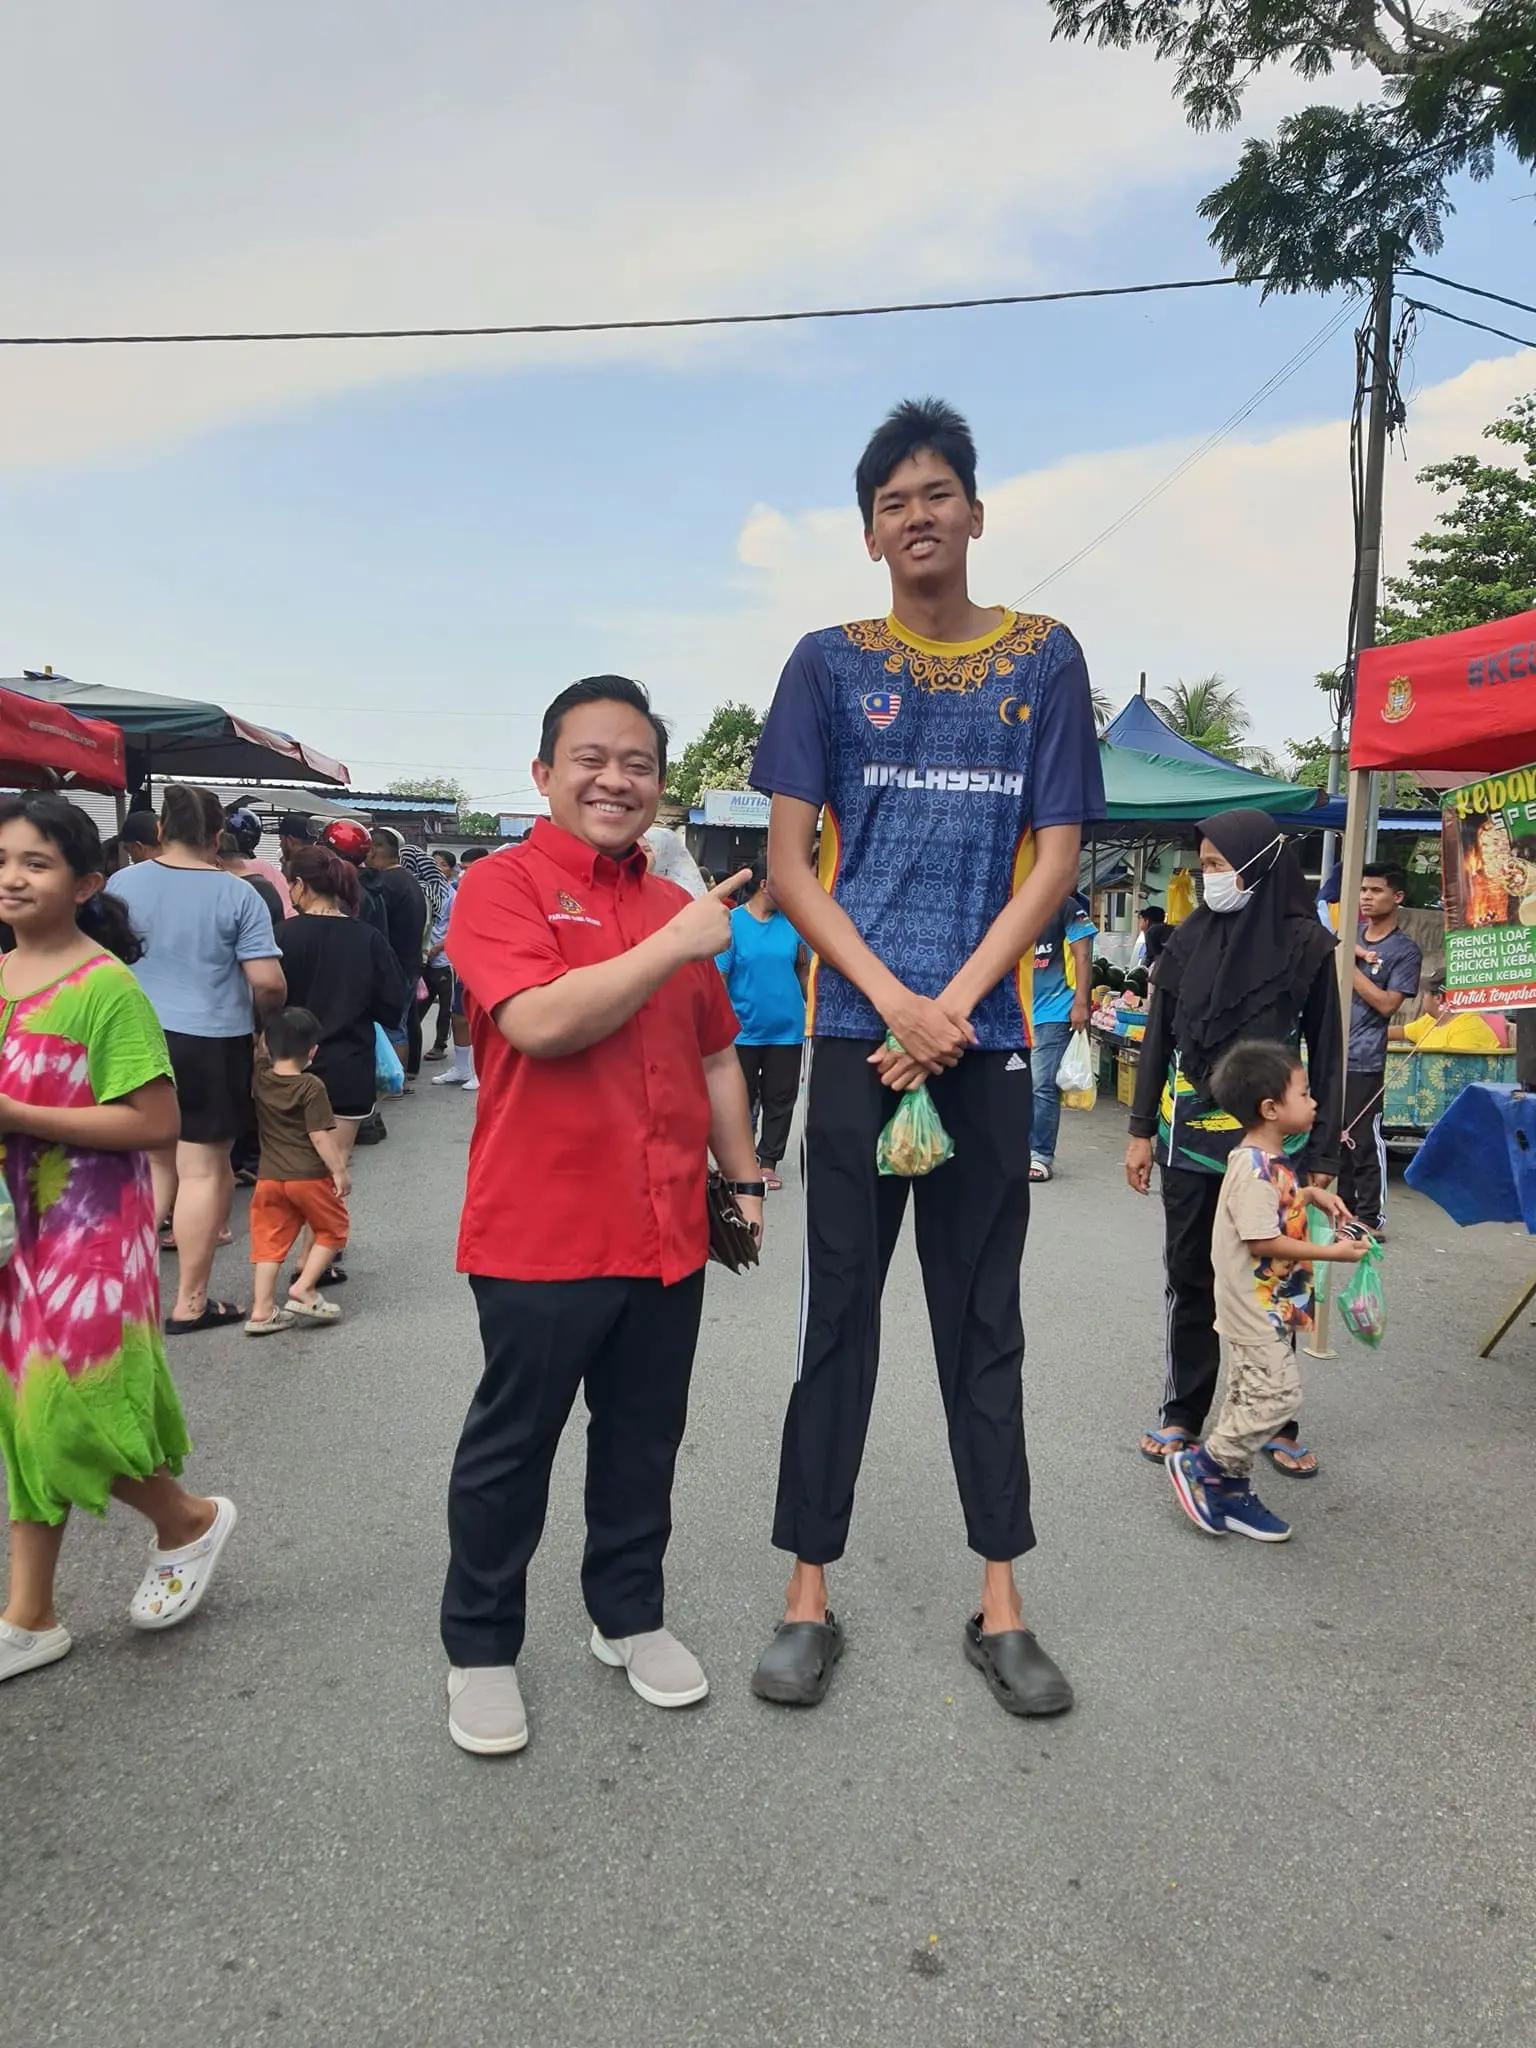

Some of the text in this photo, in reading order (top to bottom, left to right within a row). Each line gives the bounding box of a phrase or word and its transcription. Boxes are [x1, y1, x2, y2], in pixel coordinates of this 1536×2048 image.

[864, 766, 1024, 795] MALAYSIA
[731, 796, 770, 806] MUTIA
[1450, 928, 1531, 948] FRENCH LOAF
[1450, 941, 1532, 960] FRENCH LOAF
[1450, 958, 1499, 972] CHICKEN
[1450, 968, 1532, 985] CHICKEN KEBAB
[1451, 989, 1488, 1005] Untuk
